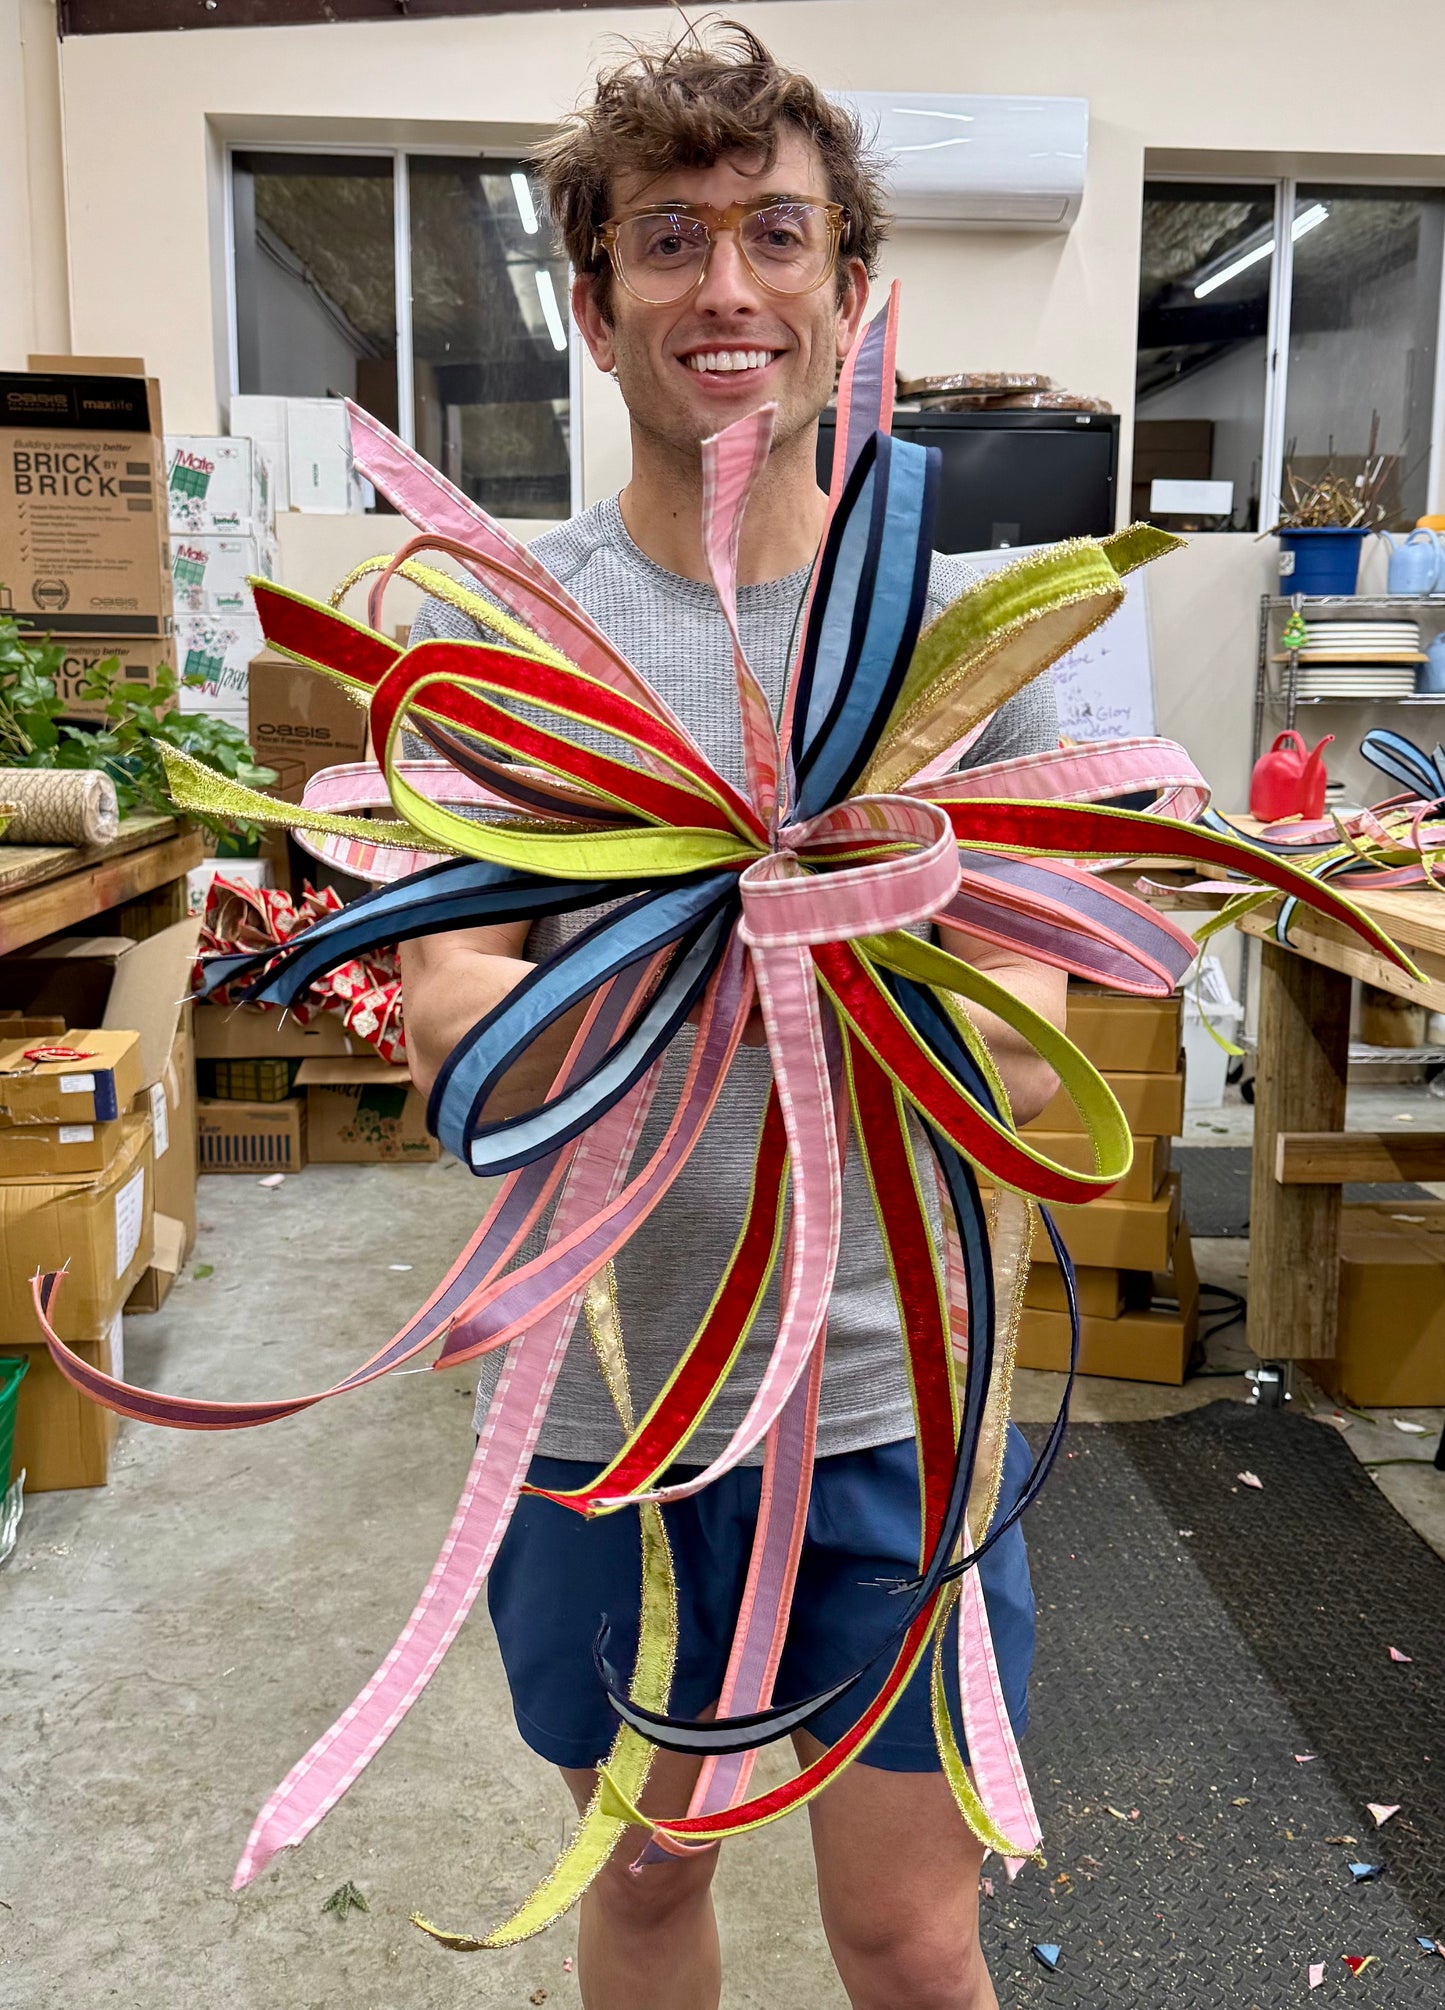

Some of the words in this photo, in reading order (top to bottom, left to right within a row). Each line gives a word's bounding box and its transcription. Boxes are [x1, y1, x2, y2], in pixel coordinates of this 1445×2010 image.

[13, 440, 52, 451] Building
[53, 442, 101, 453] something
[103, 443, 131, 452] better
[13, 452, 101, 475] BRICK
[103, 460, 118, 470] BY
[15, 474, 118, 498] BRICK
[102, 646, 130, 656] better
